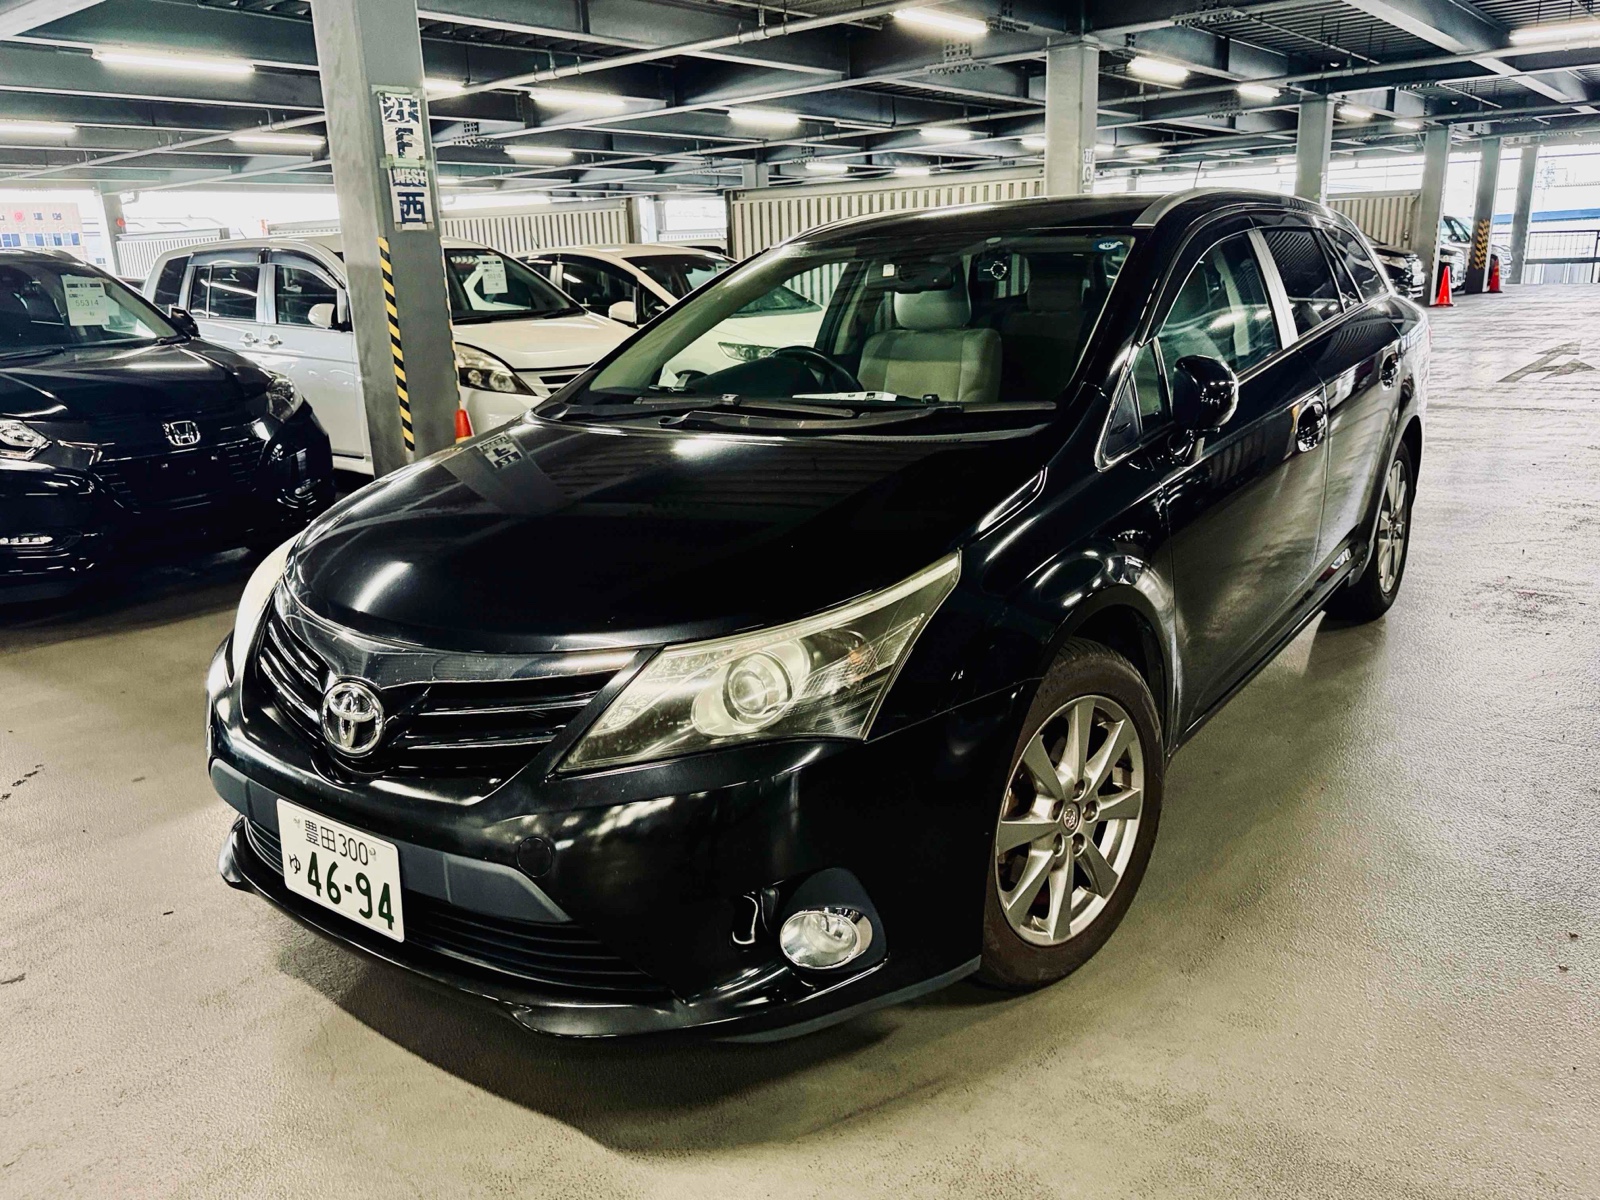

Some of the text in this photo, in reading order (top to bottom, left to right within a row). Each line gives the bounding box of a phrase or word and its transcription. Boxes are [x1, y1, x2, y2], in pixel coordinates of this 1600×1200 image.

[395, 127, 413, 158] F
[393, 168, 427, 185] WEST
[397, 192, 426, 224] 西
[288, 853, 301, 875] ゆ
[307, 851, 395, 931] 46-94
